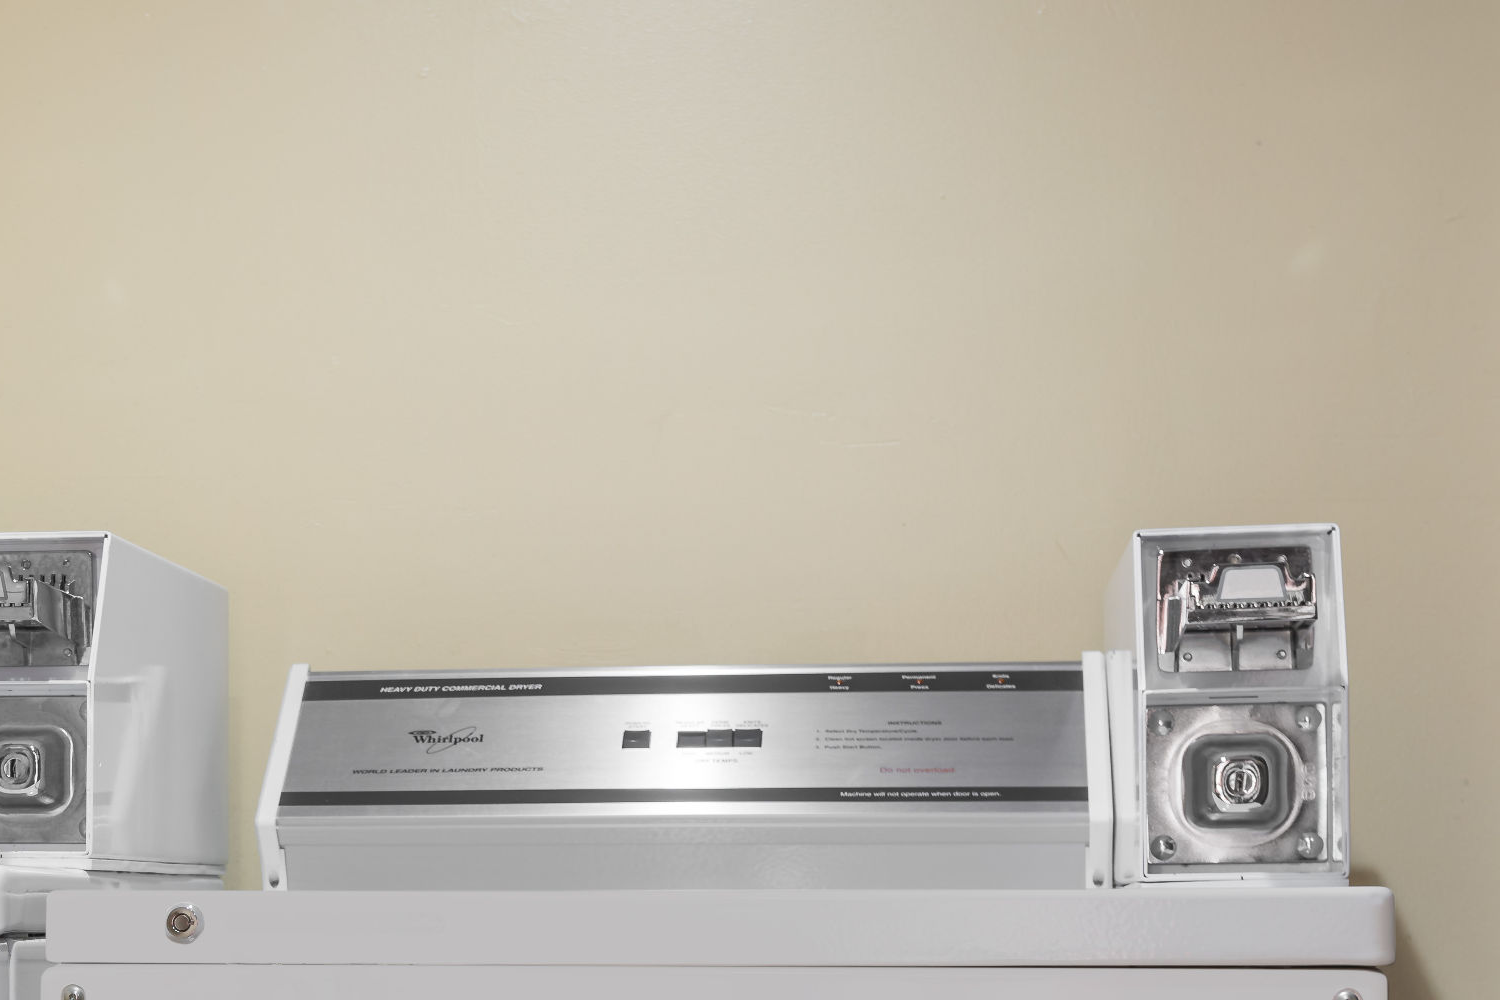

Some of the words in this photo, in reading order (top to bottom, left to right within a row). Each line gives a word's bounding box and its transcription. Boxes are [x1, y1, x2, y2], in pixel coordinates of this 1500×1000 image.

[414, 685, 441, 693] DUTY
[441, 684, 507, 692] COMMERCIAL
[839, 790, 873, 798] Machine
[873, 790, 886, 798] will
[887, 790, 900, 798] not
[900, 791, 930, 799] operate
[930, 790, 952, 798] when
[952, 790, 971, 798] door
[979, 790, 1003, 799] open.
